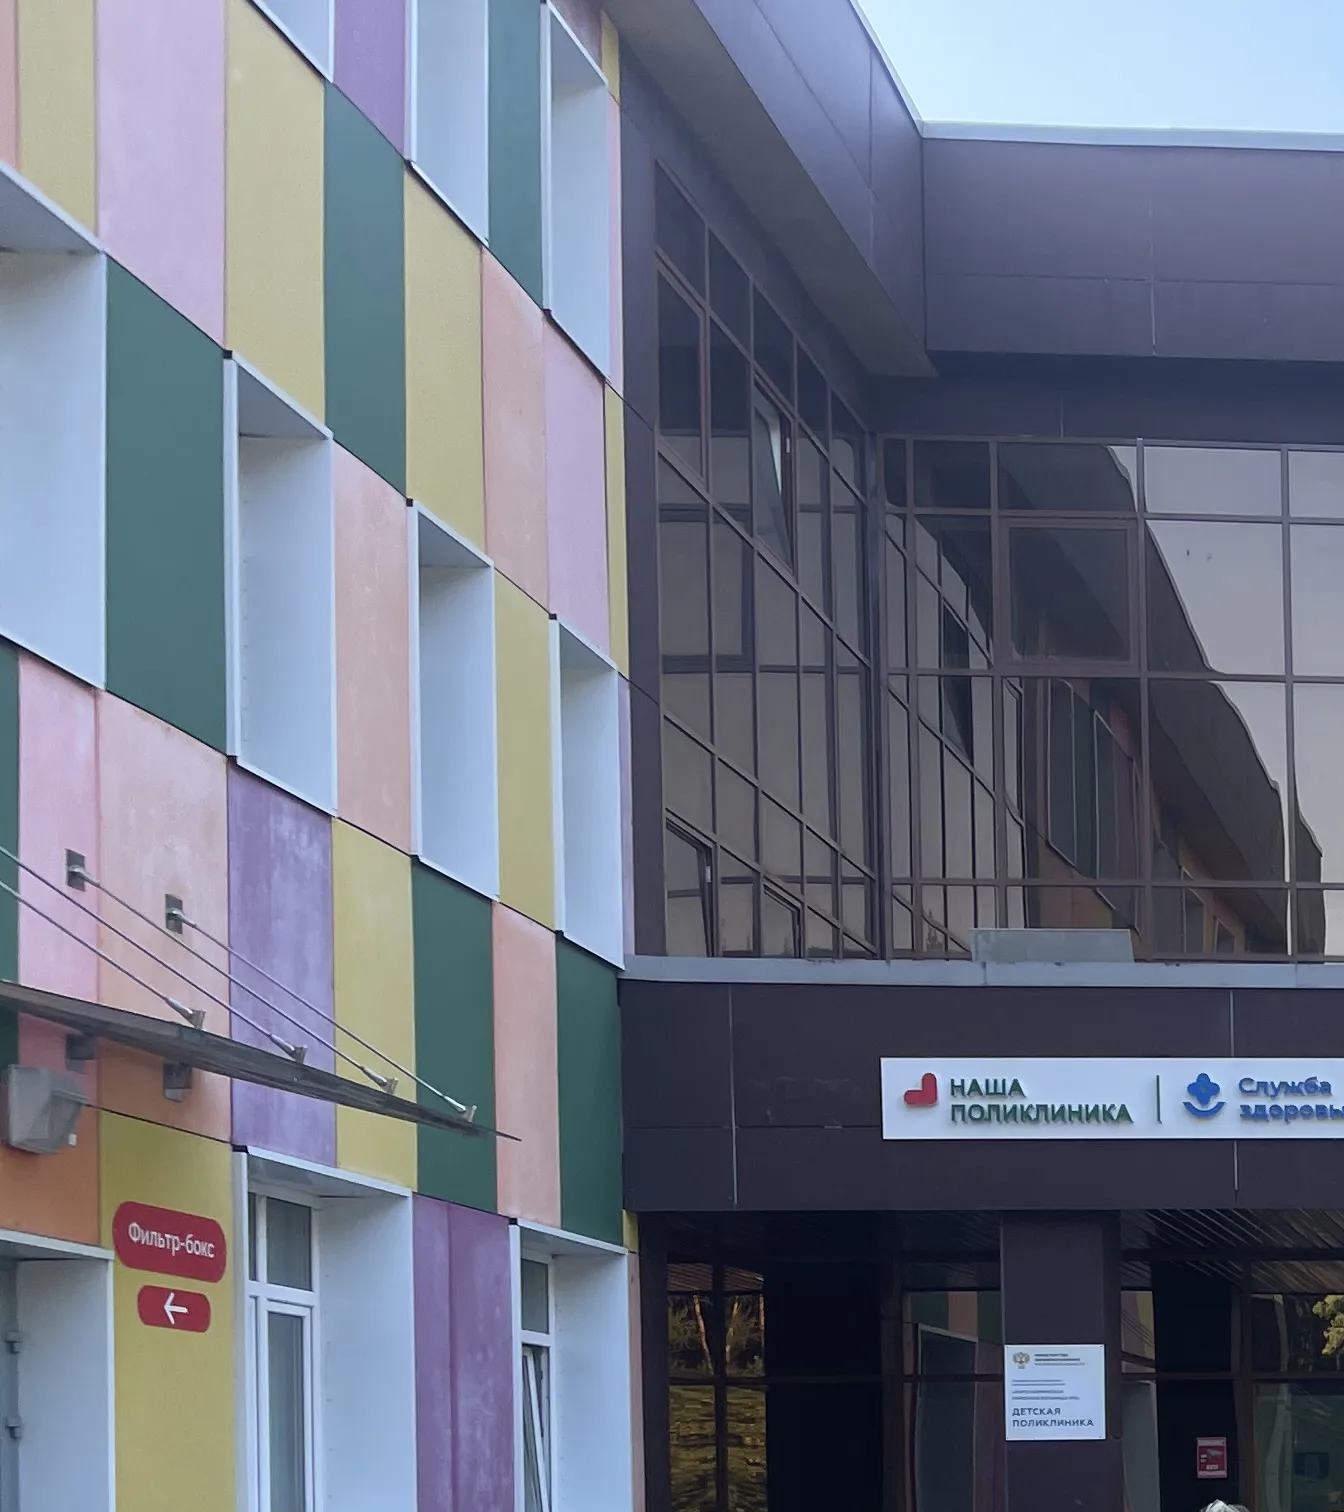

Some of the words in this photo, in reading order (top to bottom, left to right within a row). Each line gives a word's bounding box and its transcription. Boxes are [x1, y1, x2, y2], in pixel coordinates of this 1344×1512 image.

[950, 1078, 1026, 1098] НАША
[1239, 1076, 1332, 1098] Служба
[951, 1103, 1134, 1124] ПОЛИКЛИНИКА
[128, 1222, 215, 1258] Фильтр-бокс
[1012, 1408, 1061, 1416] ДЕТСКАЯ
[1012, 1419, 1094, 1427] ПОЛИКЛИНИКА
